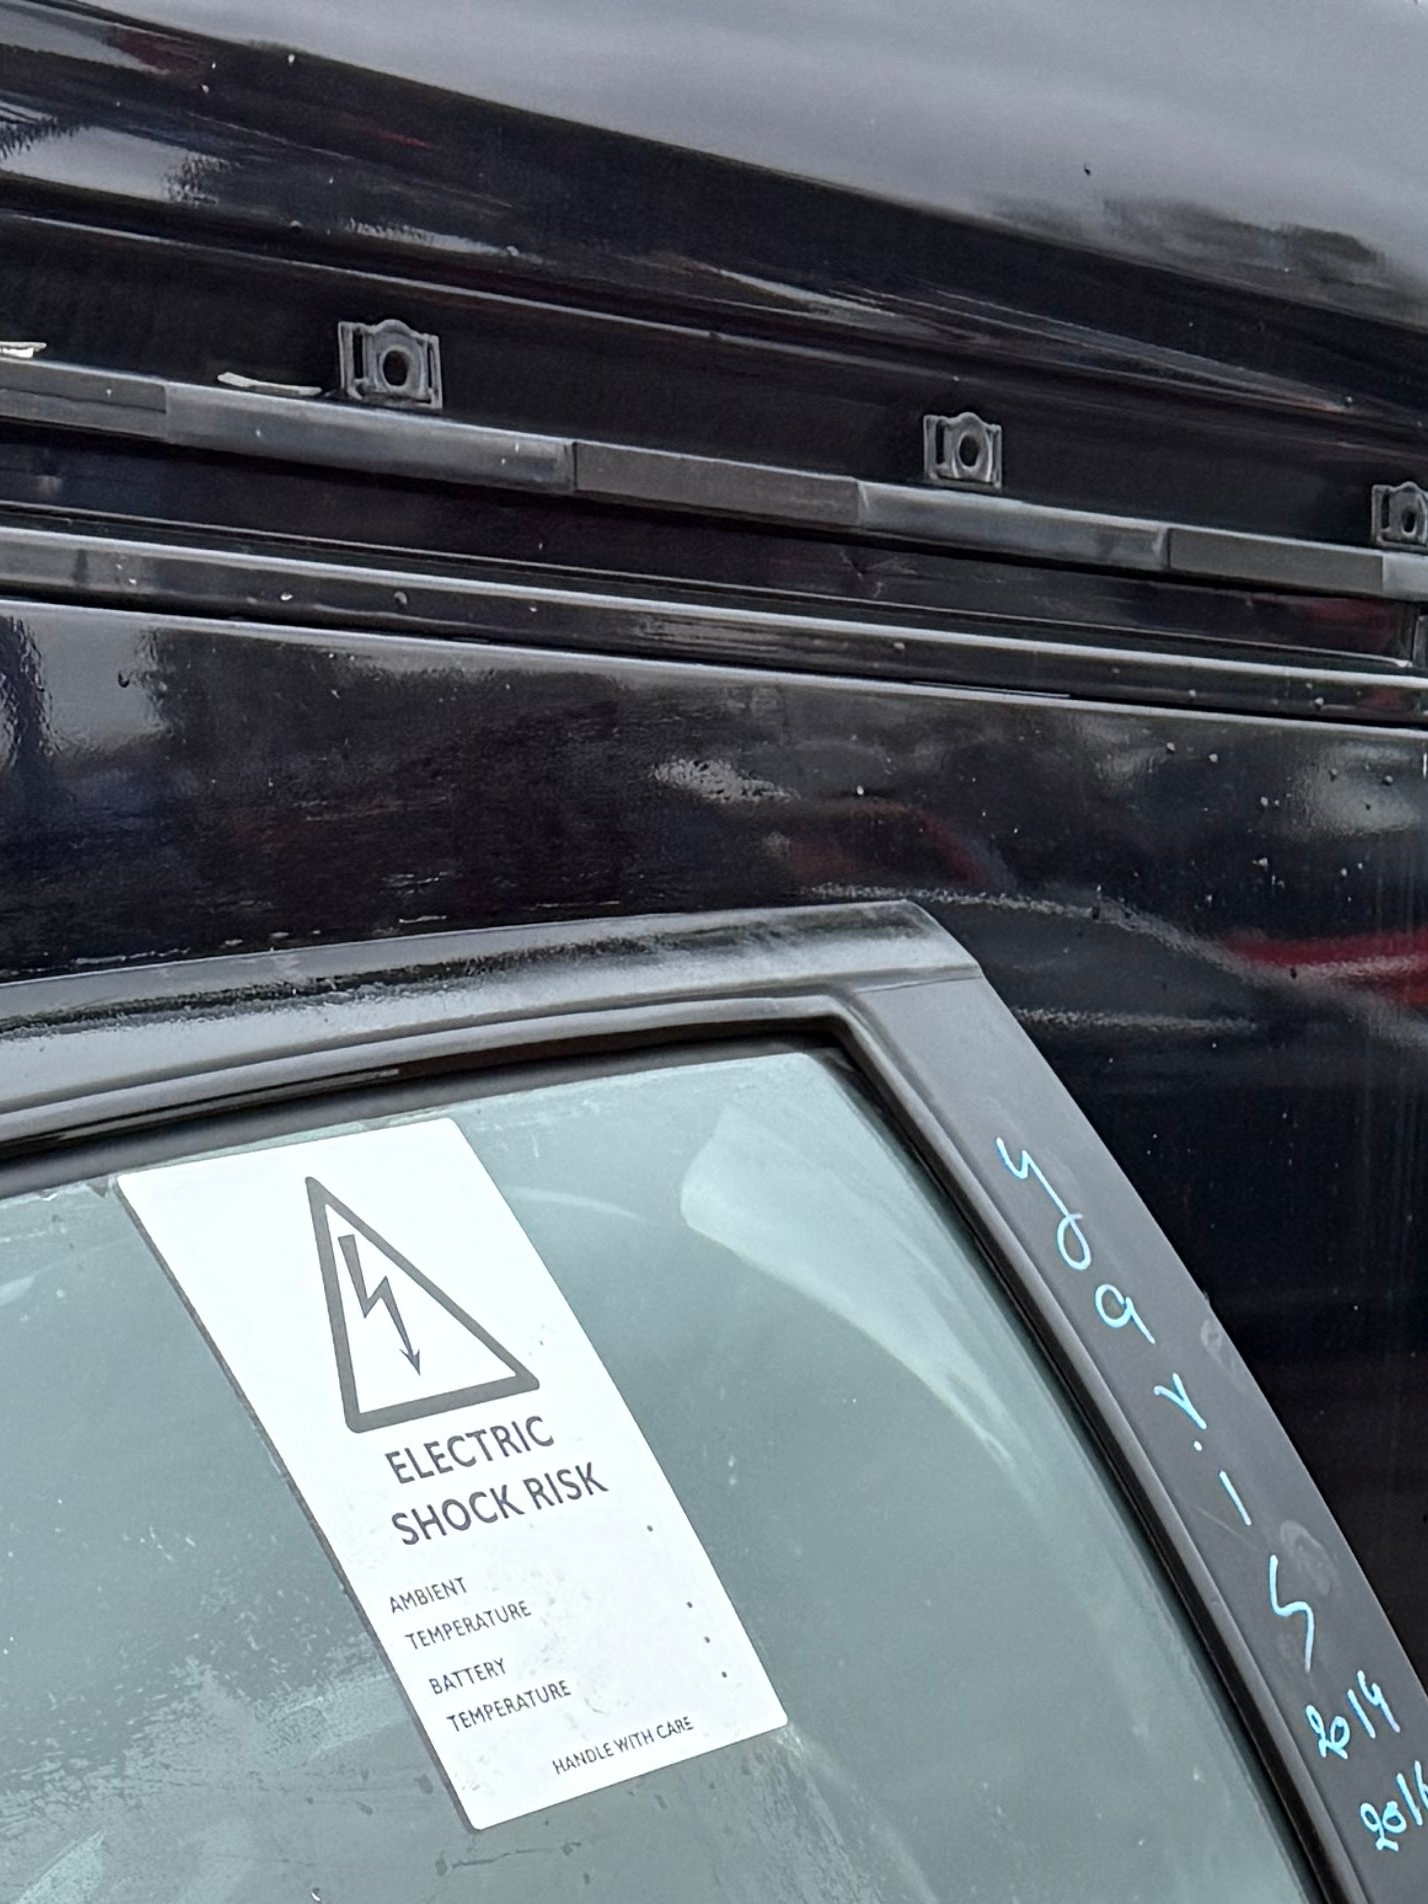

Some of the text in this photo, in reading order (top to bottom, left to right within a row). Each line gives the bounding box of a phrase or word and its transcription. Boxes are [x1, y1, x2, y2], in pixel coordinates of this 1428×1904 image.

[384, 1415, 555, 1484] ELECTRIC
[391, 1461, 609, 1546] SHOCK RISK
[389, 1576, 469, 1614] AMBIENT
[404, 1600, 532, 1650] TEMPERATURE
[428, 1658, 509, 1696] BATTERY
[446, 1679, 572, 1732] TEMPERATURE
[1305, 1670, 1401, 1760] 2014
[551, 1715, 695, 1776] HANDLE WITH CARE
